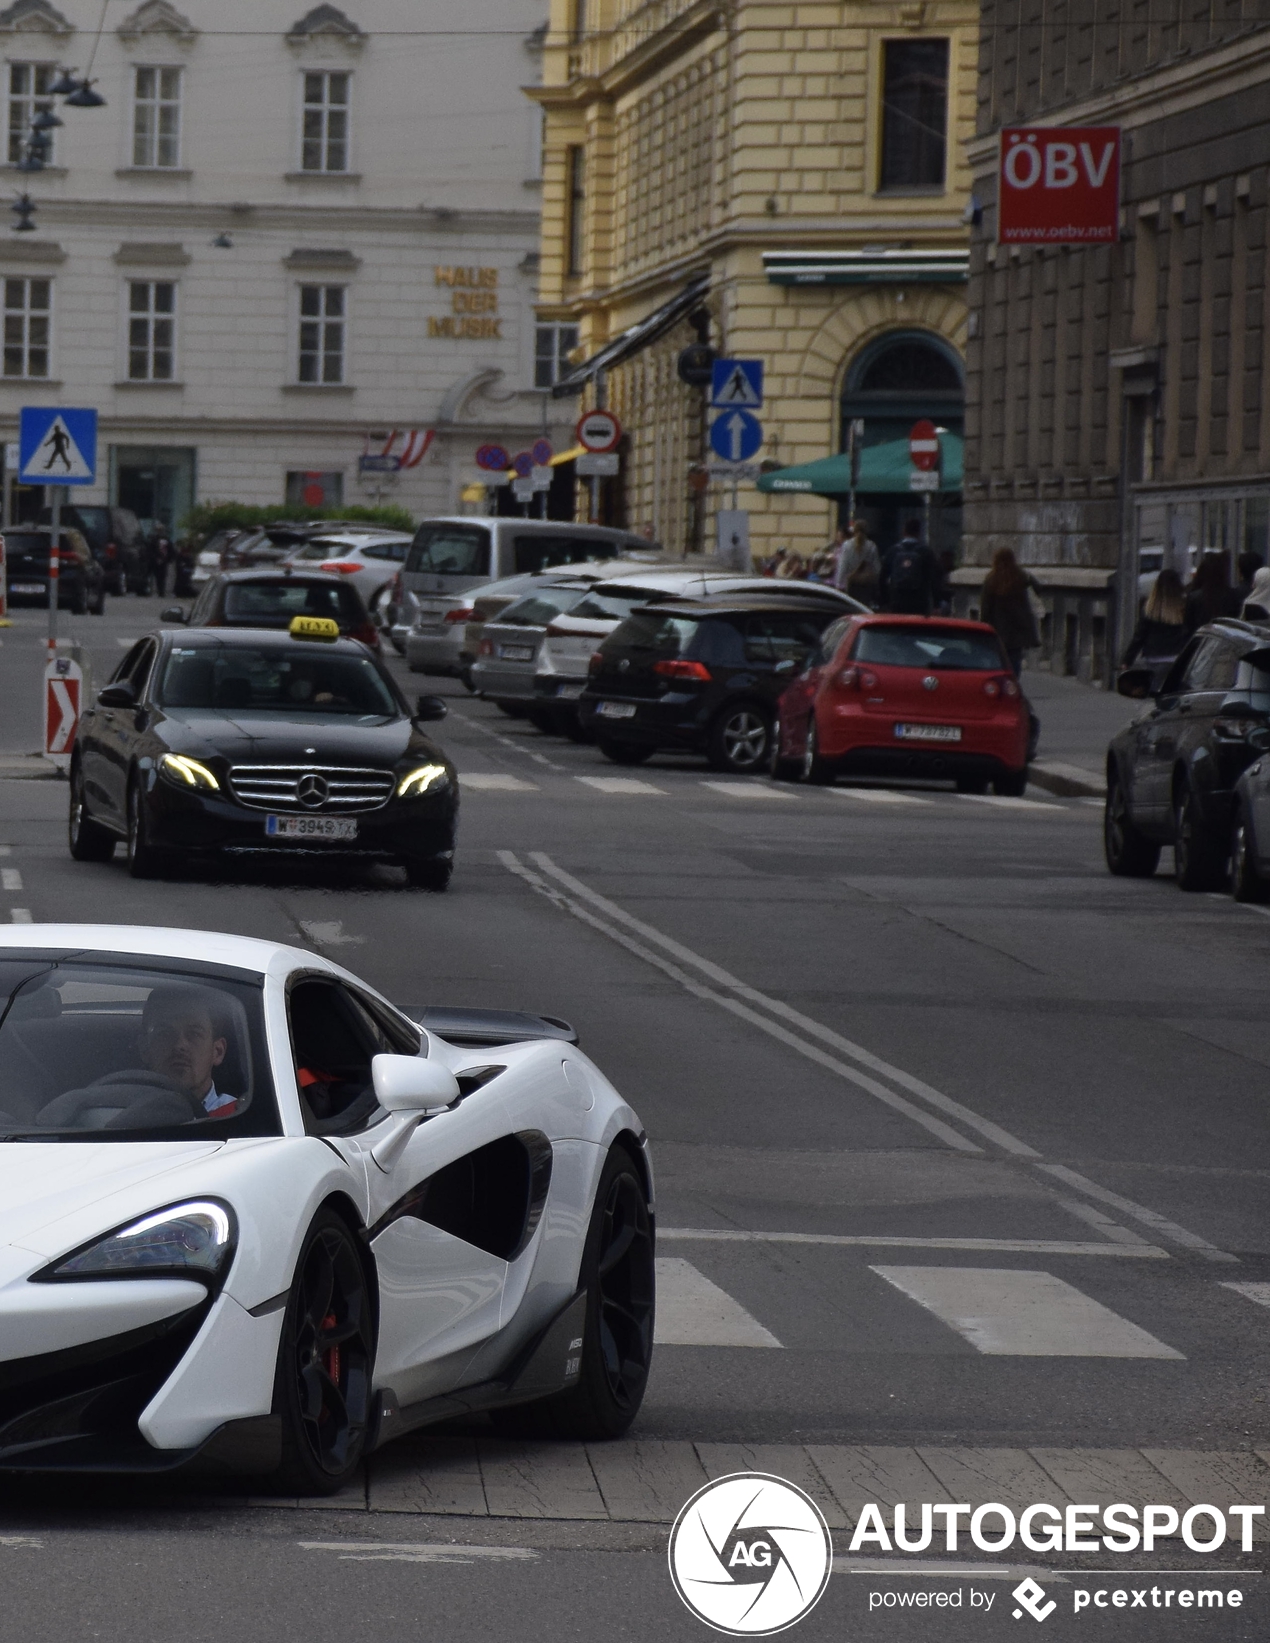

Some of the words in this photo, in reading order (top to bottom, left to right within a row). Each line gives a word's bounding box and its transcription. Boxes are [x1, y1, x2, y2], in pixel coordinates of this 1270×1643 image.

[1004, 133, 1115, 190] ÖBV
[1005, 224, 1112, 238] www.oebv.net
[433, 265, 498, 288] HAUS
[453, 292, 498, 314] DER
[426, 316, 502, 339] MUSIK
[278, 819, 288, 833] W
